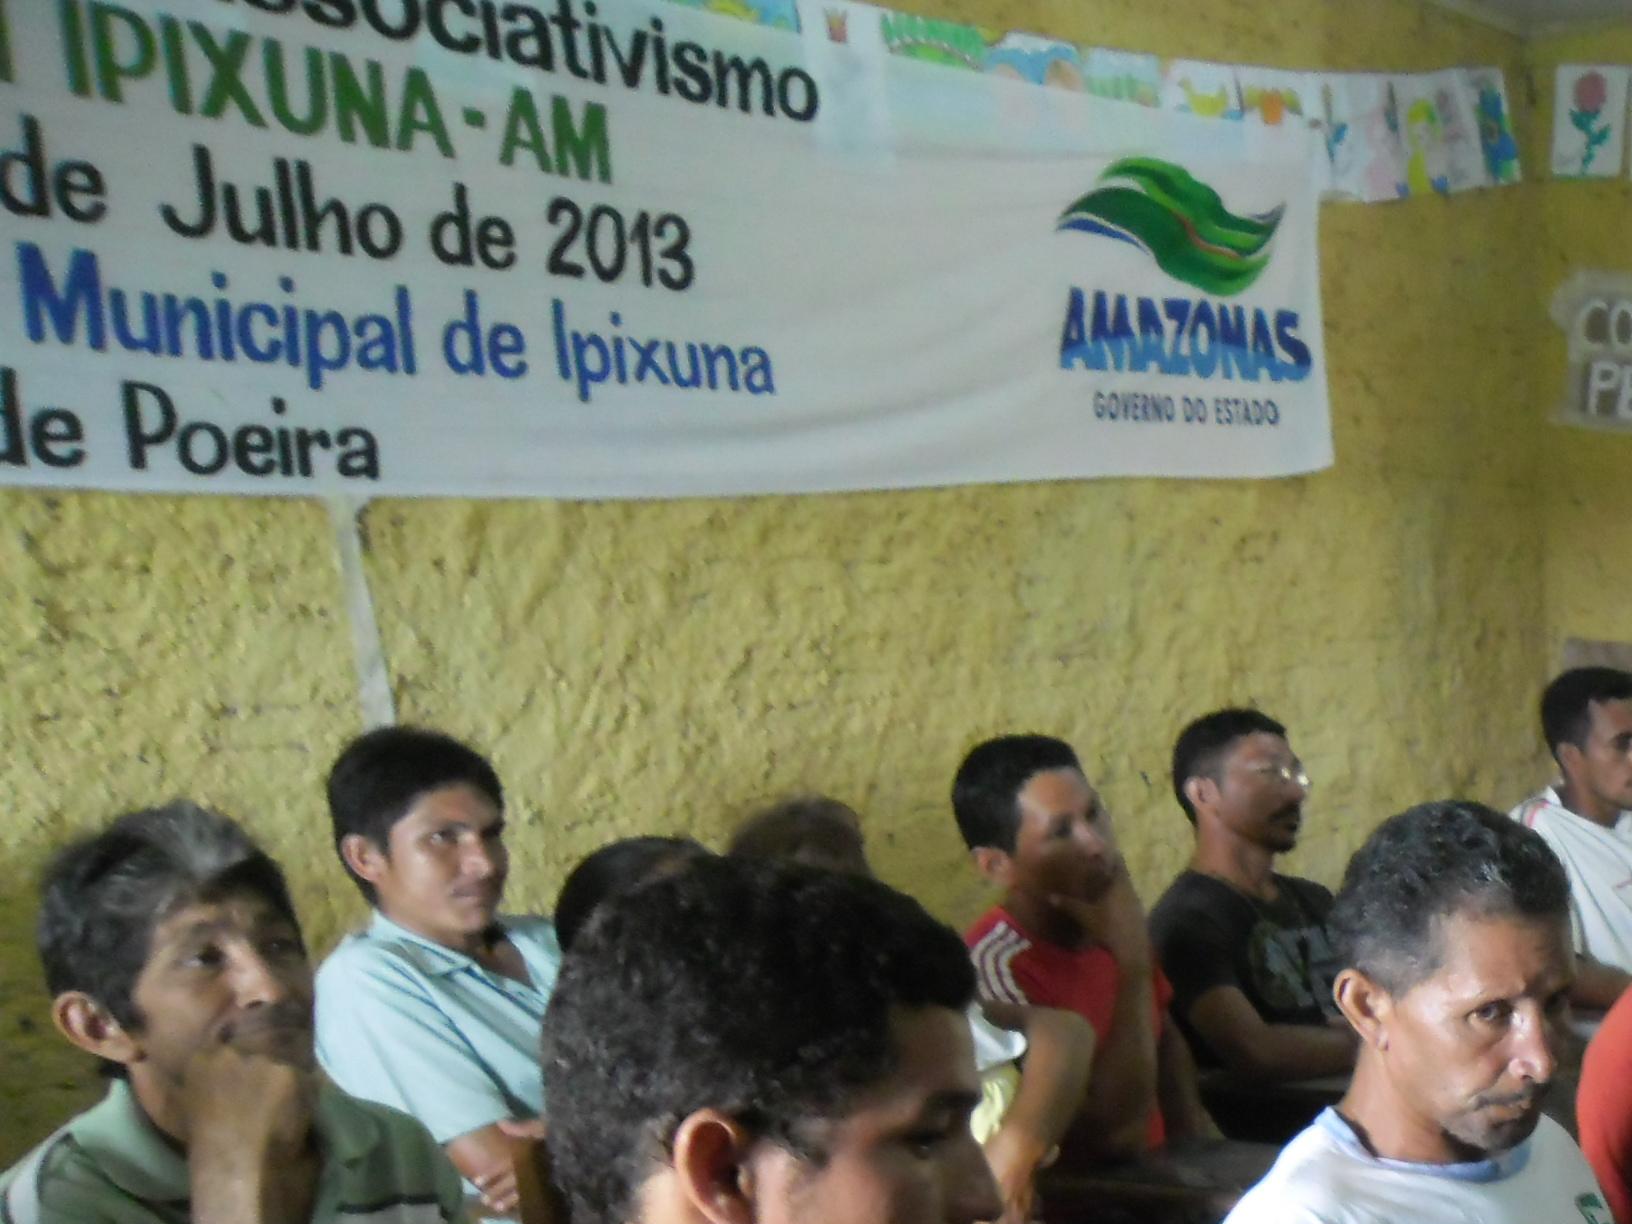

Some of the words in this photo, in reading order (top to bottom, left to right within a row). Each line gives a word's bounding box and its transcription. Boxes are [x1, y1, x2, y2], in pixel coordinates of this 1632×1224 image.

[243, 0, 820, 123] sociativismo
[0, 113, 107, 225] de
[159, 143, 404, 261] Julho
[429, 181, 517, 272] de
[546, 196, 695, 292] 2013
[15, 241, 417, 390] Municipal
[442, 288, 528, 380] de
[551, 297, 776, 403] Ipixuna
[1059, 286, 1313, 383] AMAZONAS
[120, 379, 381, 481] Poeira
[1093, 391, 1176, 423] GOVERNO
[1182, 396, 1207, 423] DO
[1214, 399, 1281, 426] ESTADO
